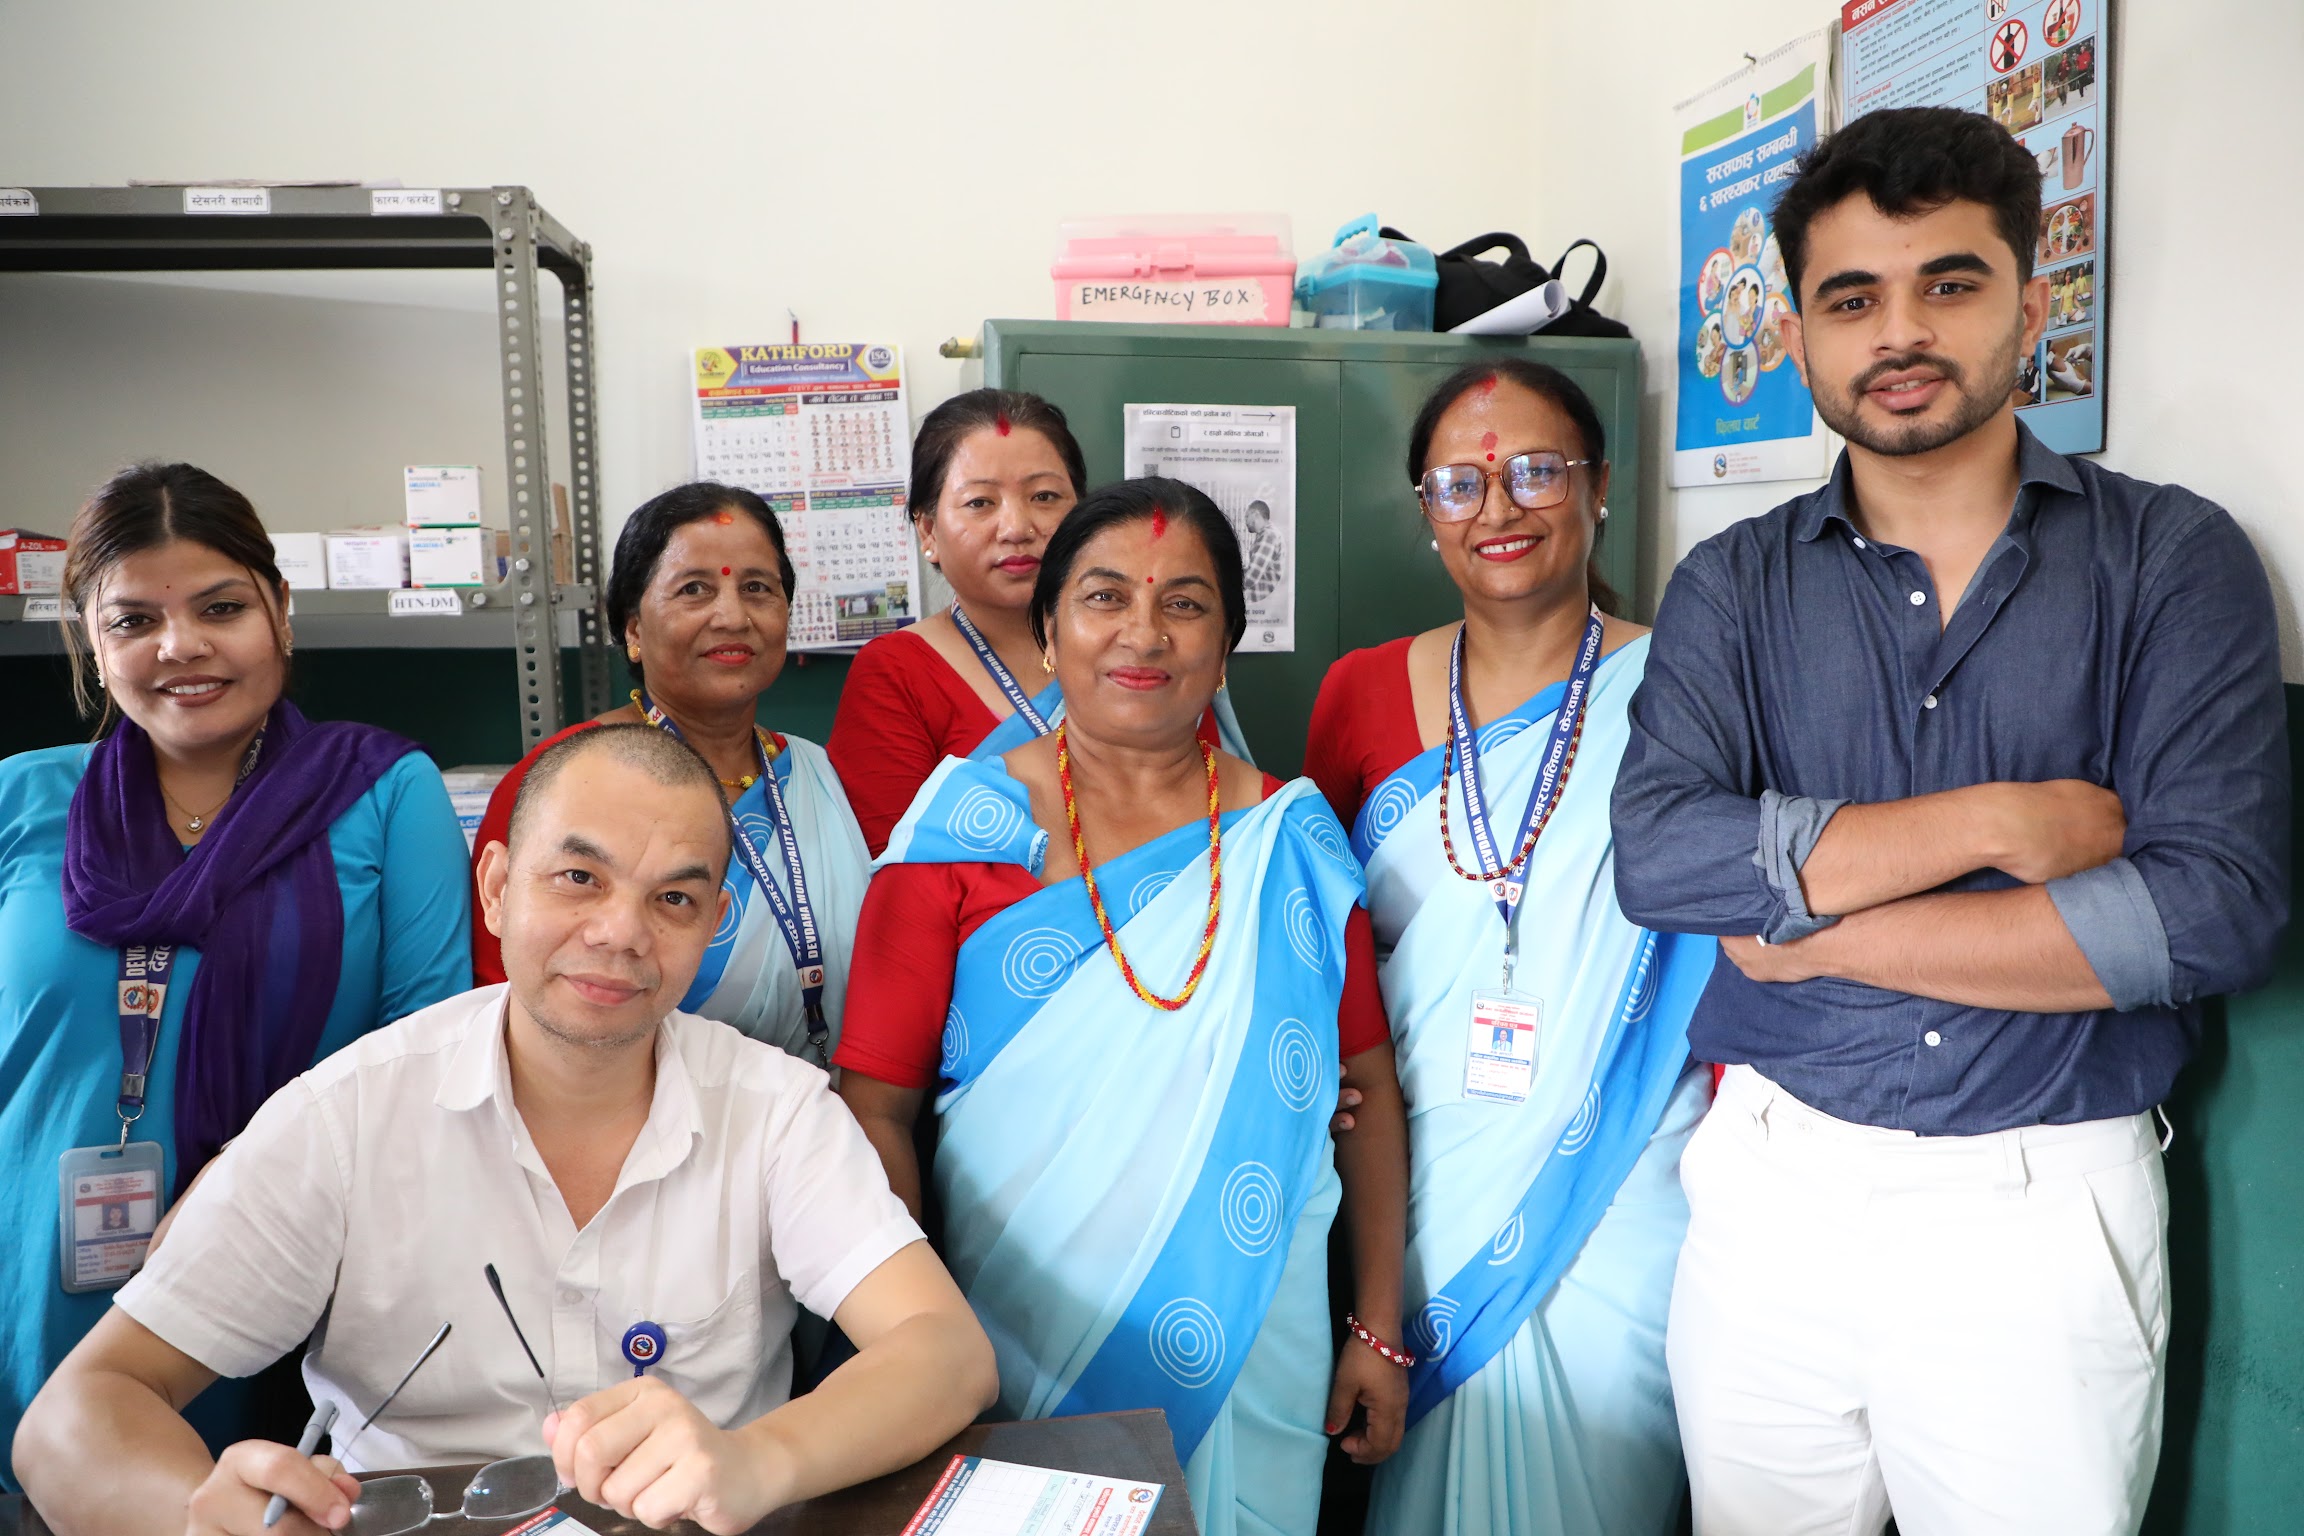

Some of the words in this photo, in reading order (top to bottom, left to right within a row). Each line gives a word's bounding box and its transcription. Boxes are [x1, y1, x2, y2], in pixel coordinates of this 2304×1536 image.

[1082, 285, 1194, 311] EMERGENCY
[1204, 289, 1250, 306] BOX
[740, 344, 853, 361] KATHFORD
[871, 350, 889, 360] ISO
[749, 363, 793, 374] Education
[793, 360, 845, 373] Consultancy
[394, 597, 454, 609] HTN-DM
[1009, 686, 1050, 736] NICIPALITY,
[1472, 815, 1499, 874] DEVDAHA
[798, 906, 819, 959] DEVDAHA
